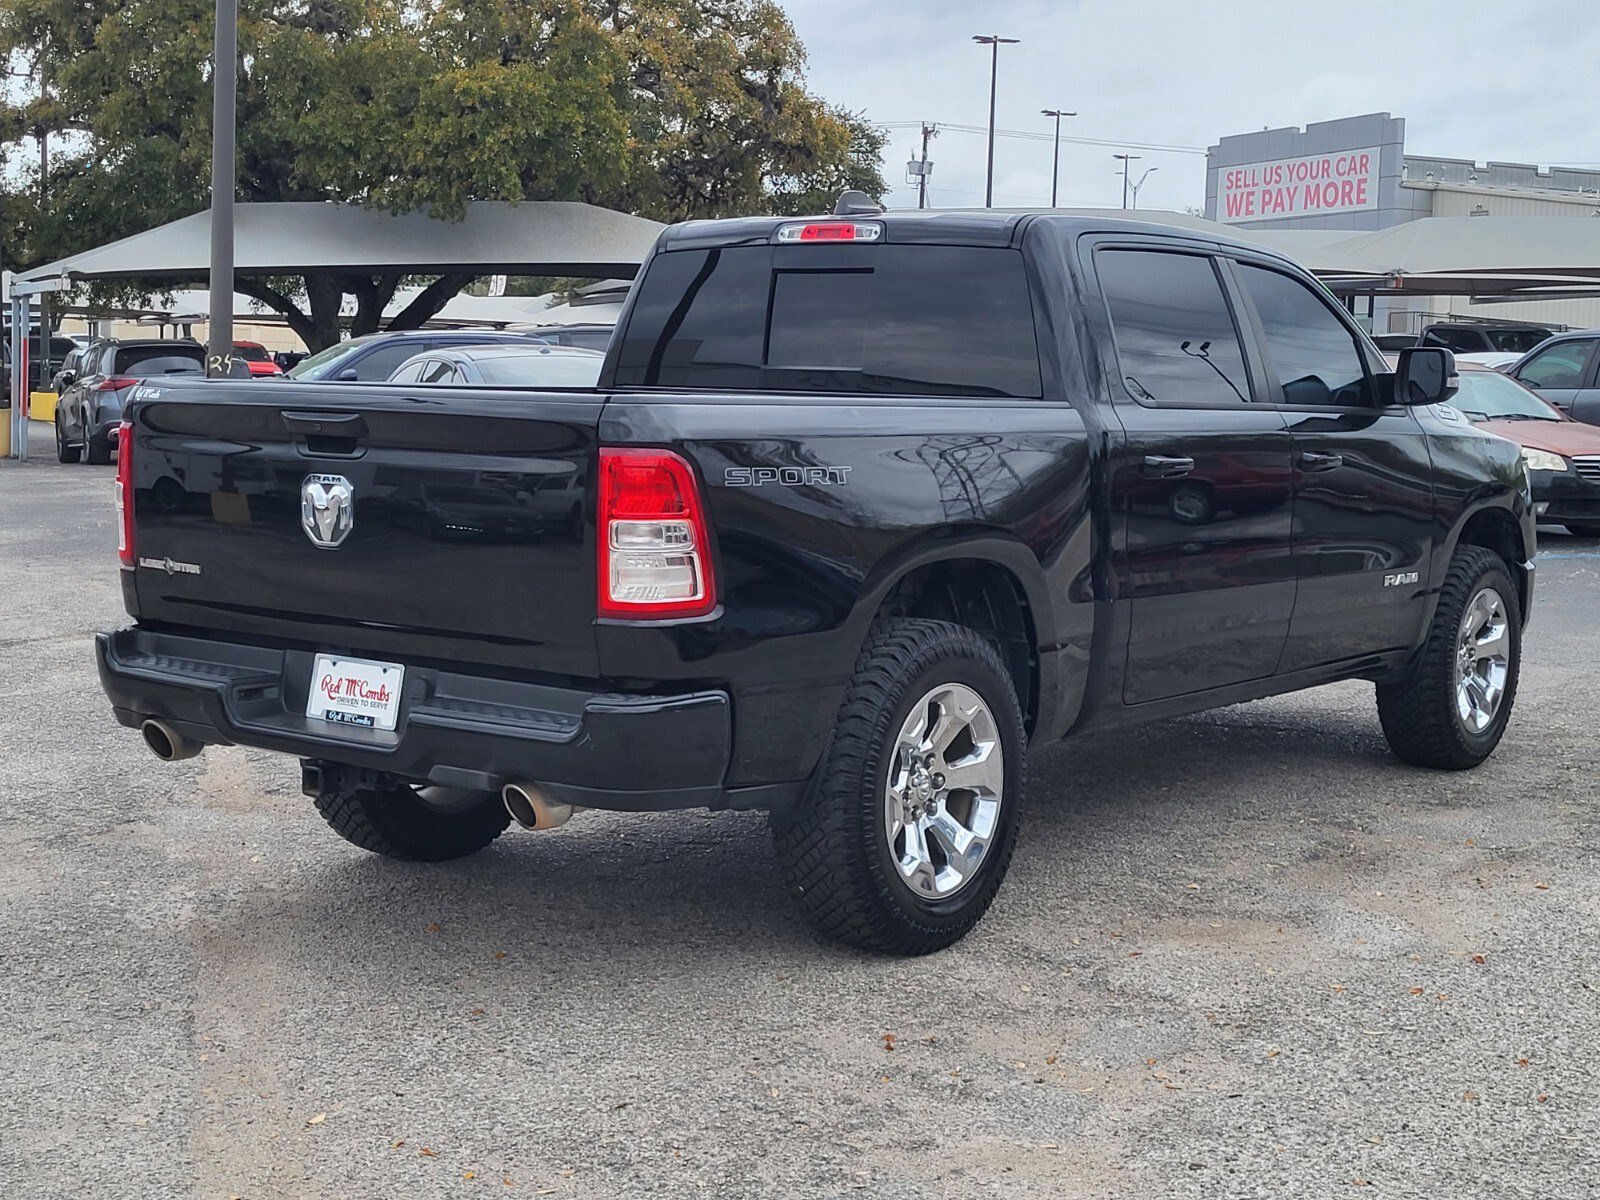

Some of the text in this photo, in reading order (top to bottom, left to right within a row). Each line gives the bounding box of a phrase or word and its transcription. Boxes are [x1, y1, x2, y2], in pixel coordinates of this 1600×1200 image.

[1226, 153, 1370, 190] SELL US YOUR CAR
[1226, 177, 1368, 218] WE PAY MORE
[309, 475, 342, 483] RAM
[724, 465, 853, 487] SPORT
[1383, 571, 1419, 587] RAM
[321, 674, 390, 702] Red McCombs
[336, 696, 359, 706] DRIVEN
[369, 701, 388, 710] SERVE
